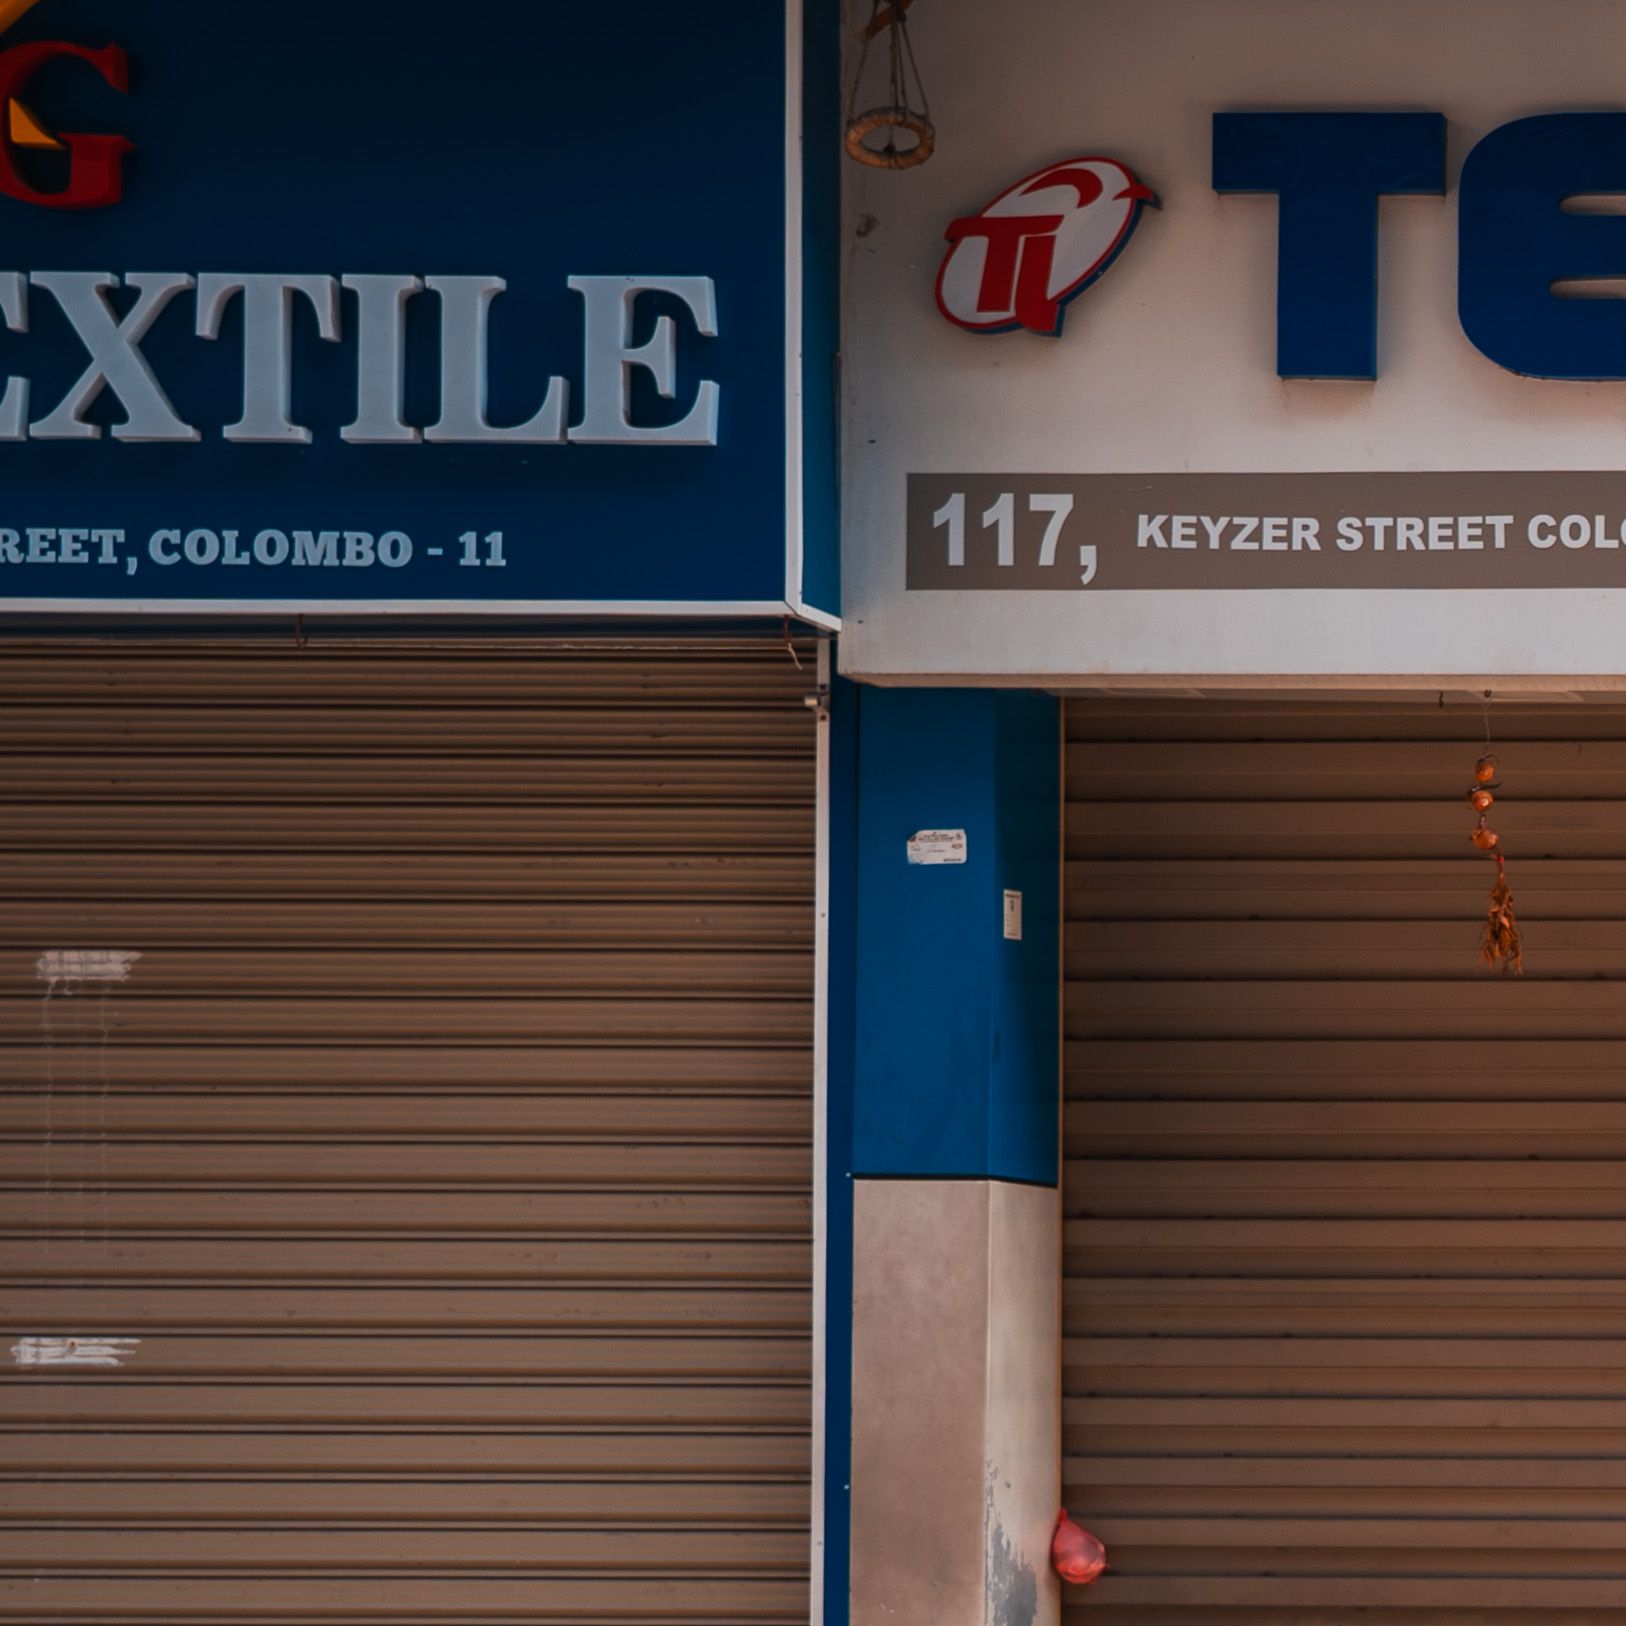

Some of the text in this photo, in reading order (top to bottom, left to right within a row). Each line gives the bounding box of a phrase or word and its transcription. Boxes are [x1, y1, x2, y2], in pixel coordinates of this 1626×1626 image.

[0, 271, 720, 446] XTILE
[148, 529, 413, 569] COLOMBO
[459, 531, 507, 567] 11
[931, 492, 1100, 585] 117,
[1137, 514, 1322, 551] KEYZER
[1336, 514, 1514, 551] STREET
